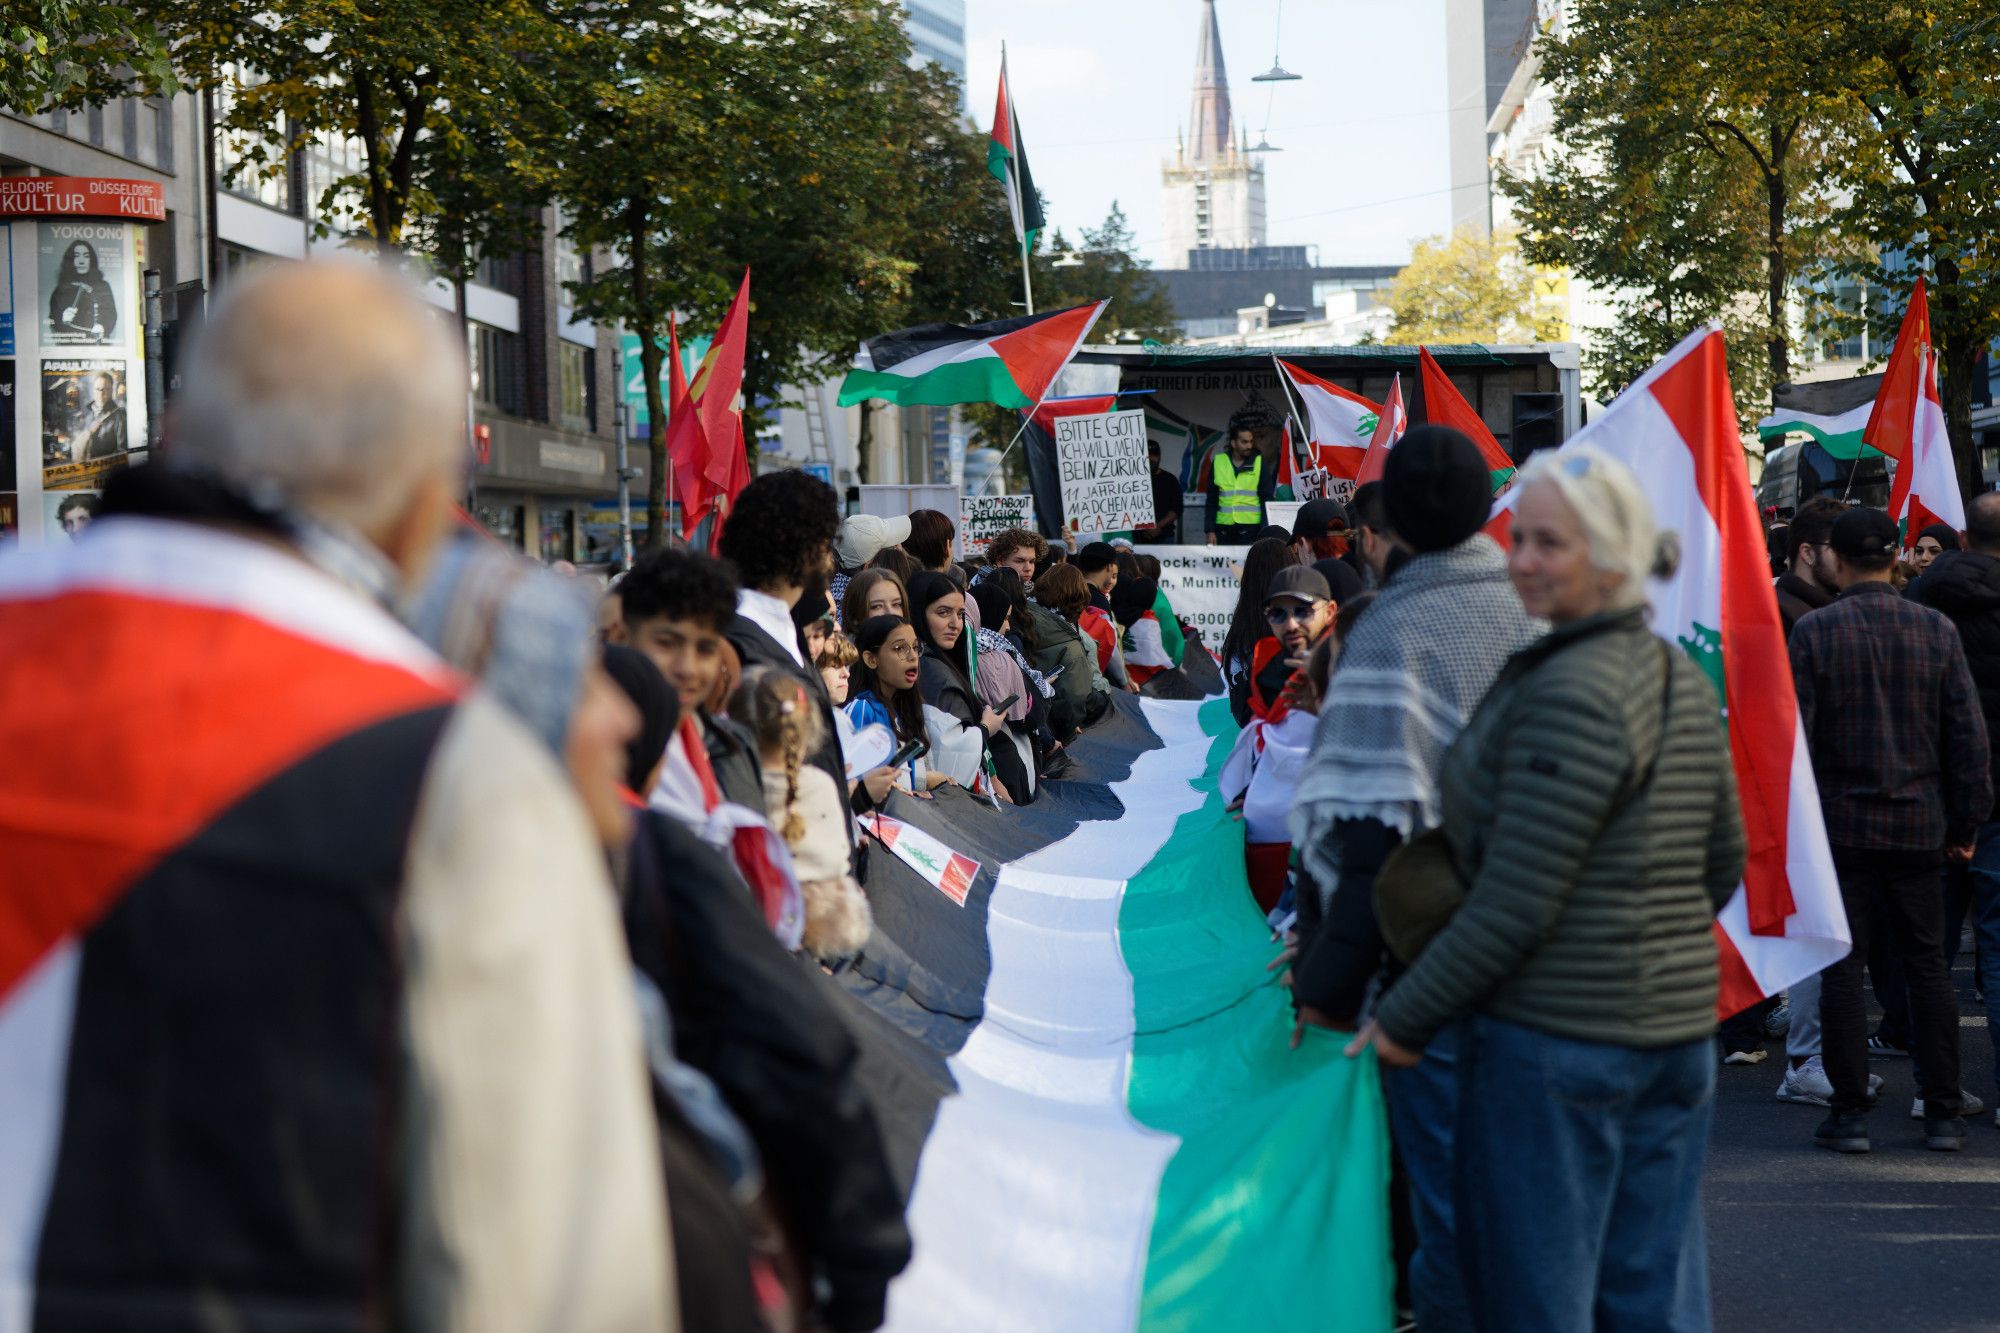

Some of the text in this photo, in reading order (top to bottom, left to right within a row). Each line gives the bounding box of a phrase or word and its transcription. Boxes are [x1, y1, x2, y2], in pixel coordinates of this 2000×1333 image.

[0, 182, 54, 194] ELDORF
[90, 181, 153, 196] DÜSSELDORF
[3, 194, 85, 212] KULTUR
[51, 226, 123, 240] YOKO ONO
[1139, 375, 1192, 390] FREIHEIT
[1196, 374, 1220, 390] FÜR
[1061, 438, 1144, 459] ICH WILL MEIN
[1062, 461, 1096, 481] BEIN
[1000, 496, 1031, 508] ABOUT
[1130, 494, 1152, 510] AUS
[973, 509, 1021, 519] RELIGION
[1081, 512, 1133, 532] GAZA
